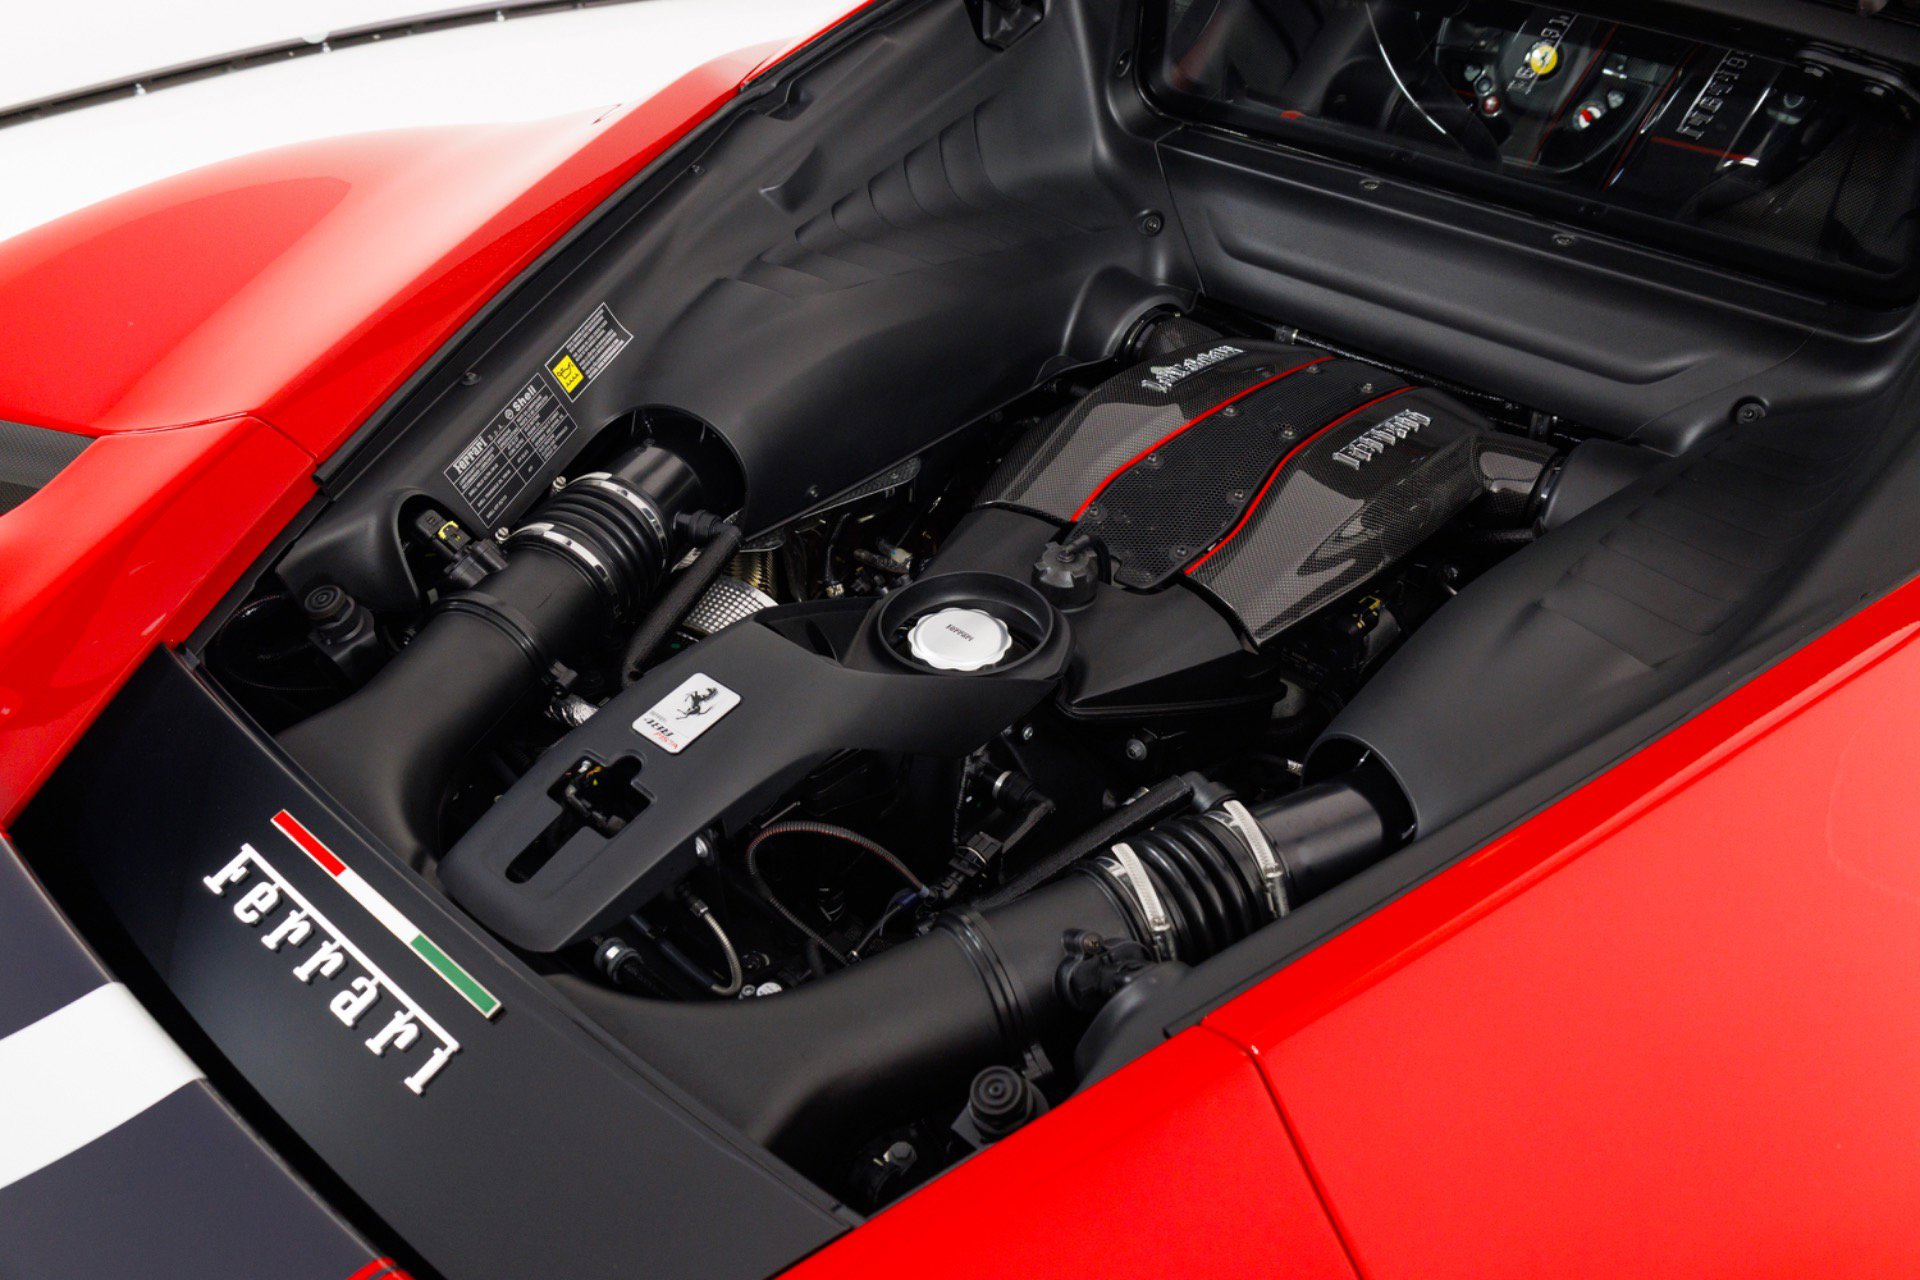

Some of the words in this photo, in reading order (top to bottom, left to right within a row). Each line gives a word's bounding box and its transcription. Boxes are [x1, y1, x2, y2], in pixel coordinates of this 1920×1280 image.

[512, 384, 537, 412] Shell
[453, 436, 488, 475] Ferrari
[1332, 408, 1431, 471] Ferrari
[945, 623, 975, 642] Ferrari
[203, 843, 460, 1094] Ferrari
